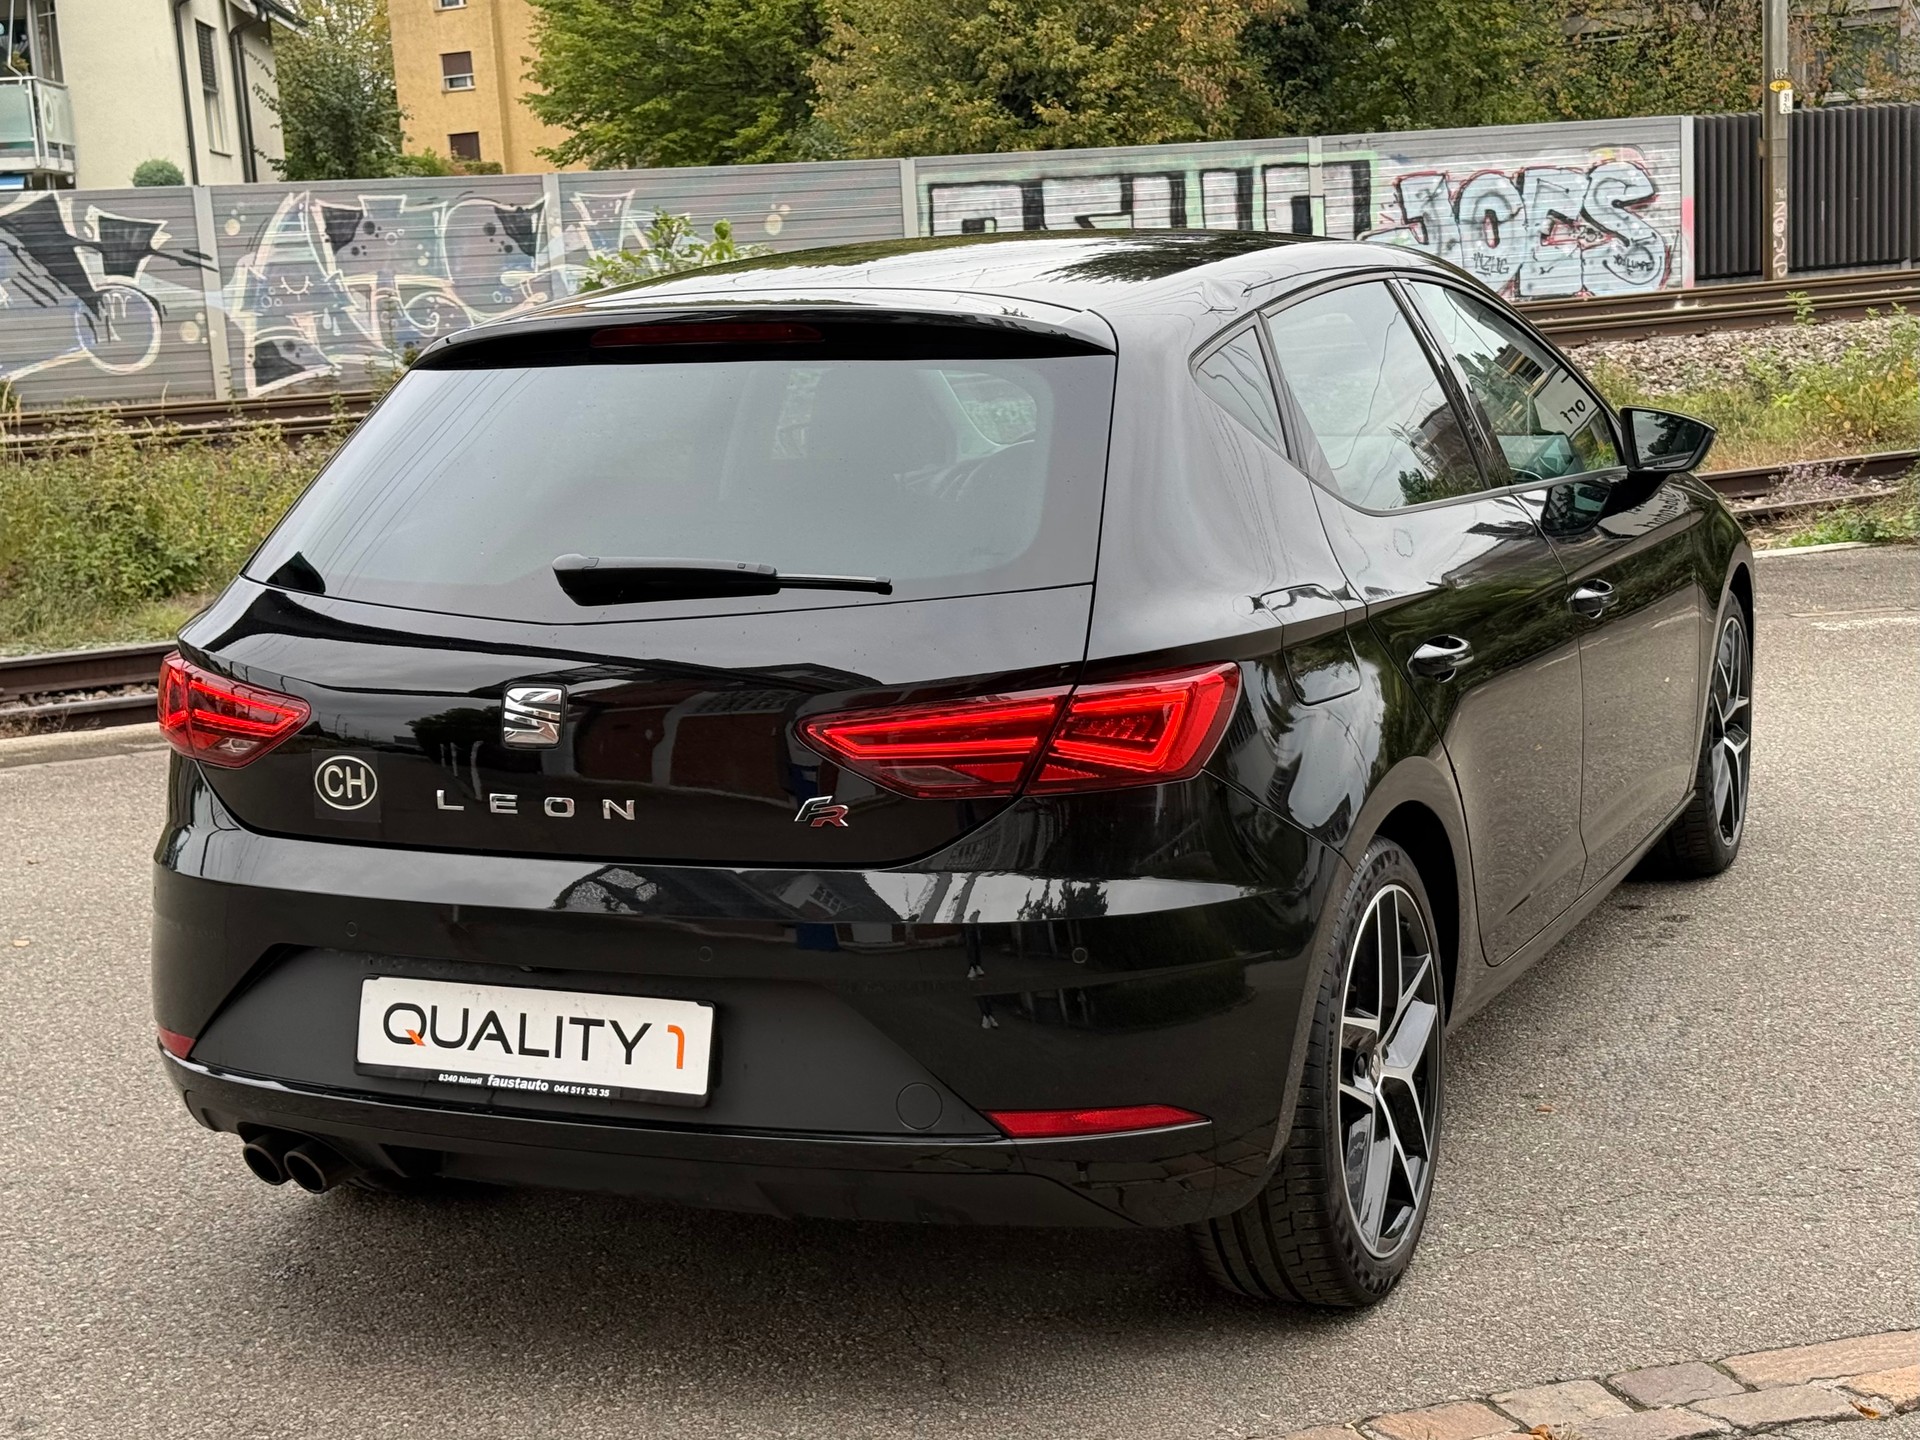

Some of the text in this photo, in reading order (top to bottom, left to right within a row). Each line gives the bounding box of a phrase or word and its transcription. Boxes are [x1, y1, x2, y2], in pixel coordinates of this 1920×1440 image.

[323, 765, 367, 800] CH
[436, 789, 635, 821] LEON
[794, 795, 849, 827] FR
[383, 1002, 685, 1070] QUALITY 1
[438, 1073, 610, 1098] 8340 hinwil faustauto 044 511 35 35
